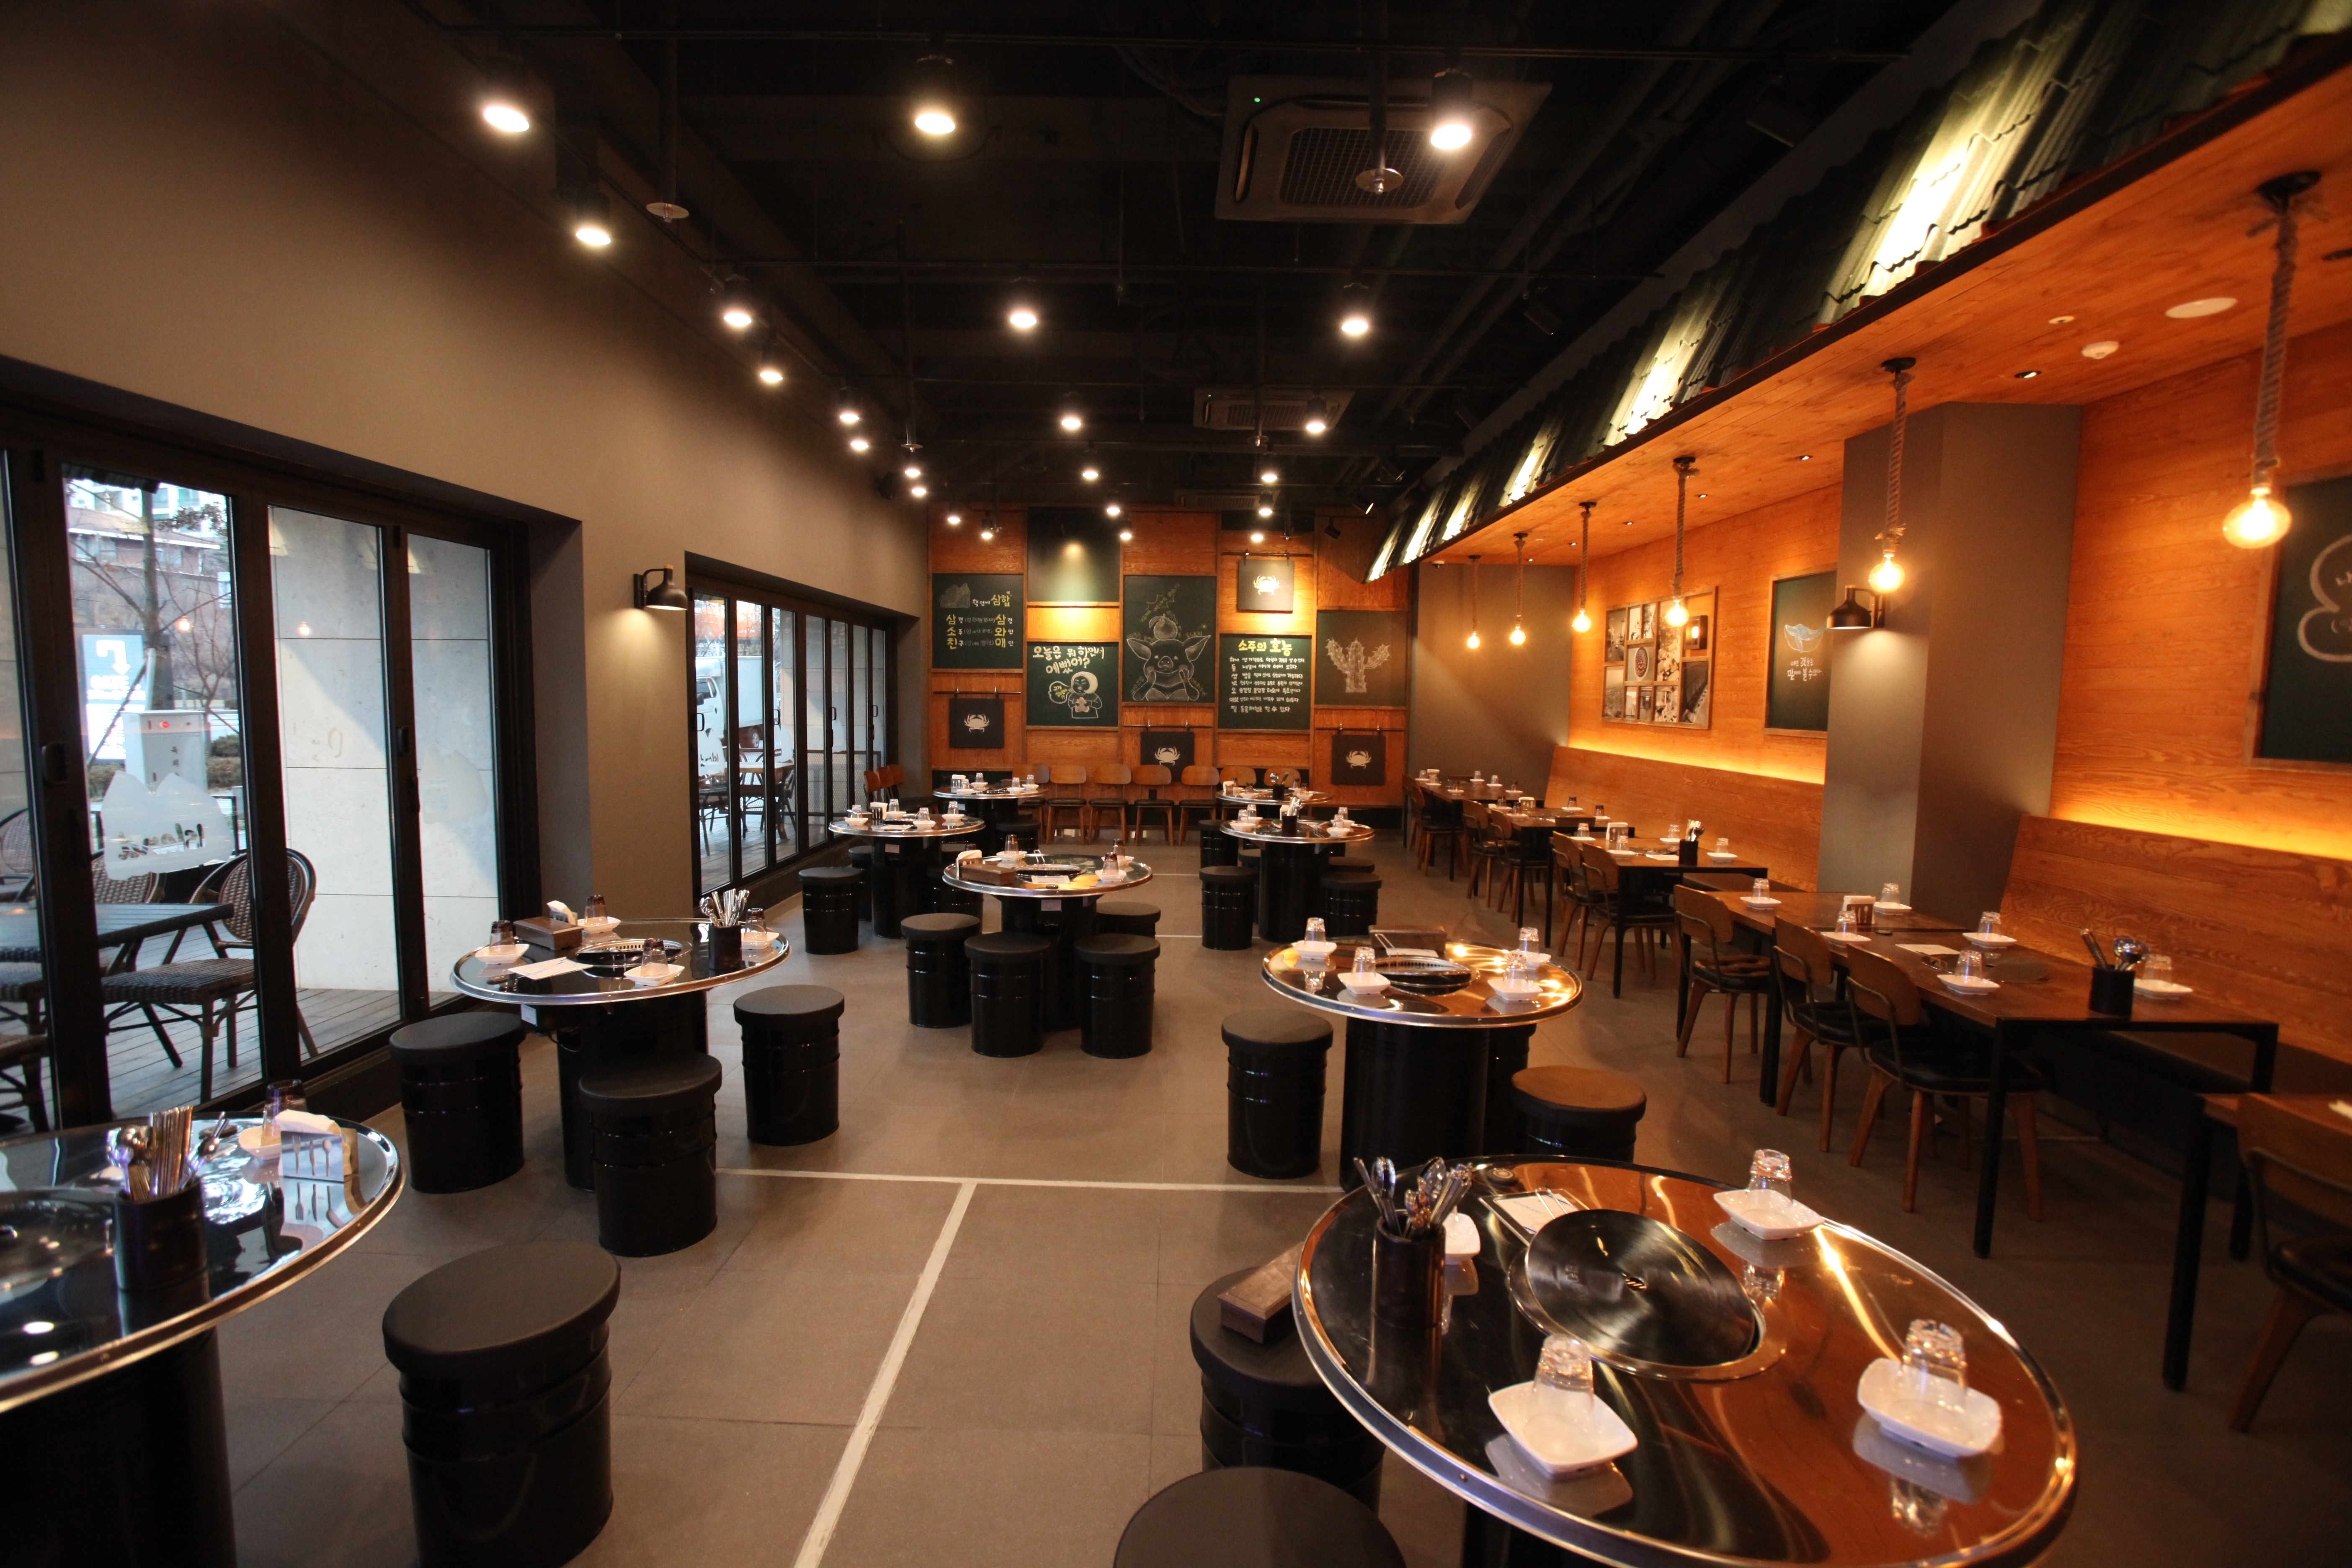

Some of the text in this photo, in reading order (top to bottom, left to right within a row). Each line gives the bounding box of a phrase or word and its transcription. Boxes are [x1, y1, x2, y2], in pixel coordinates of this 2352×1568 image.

[990, 594, 1010, 607] 삼합
[1238, 640, 1267, 652] 소주의
[1032, 646, 1104, 661] 오늘은 뭐 하면서
[90, 675, 130, 690] GATE
